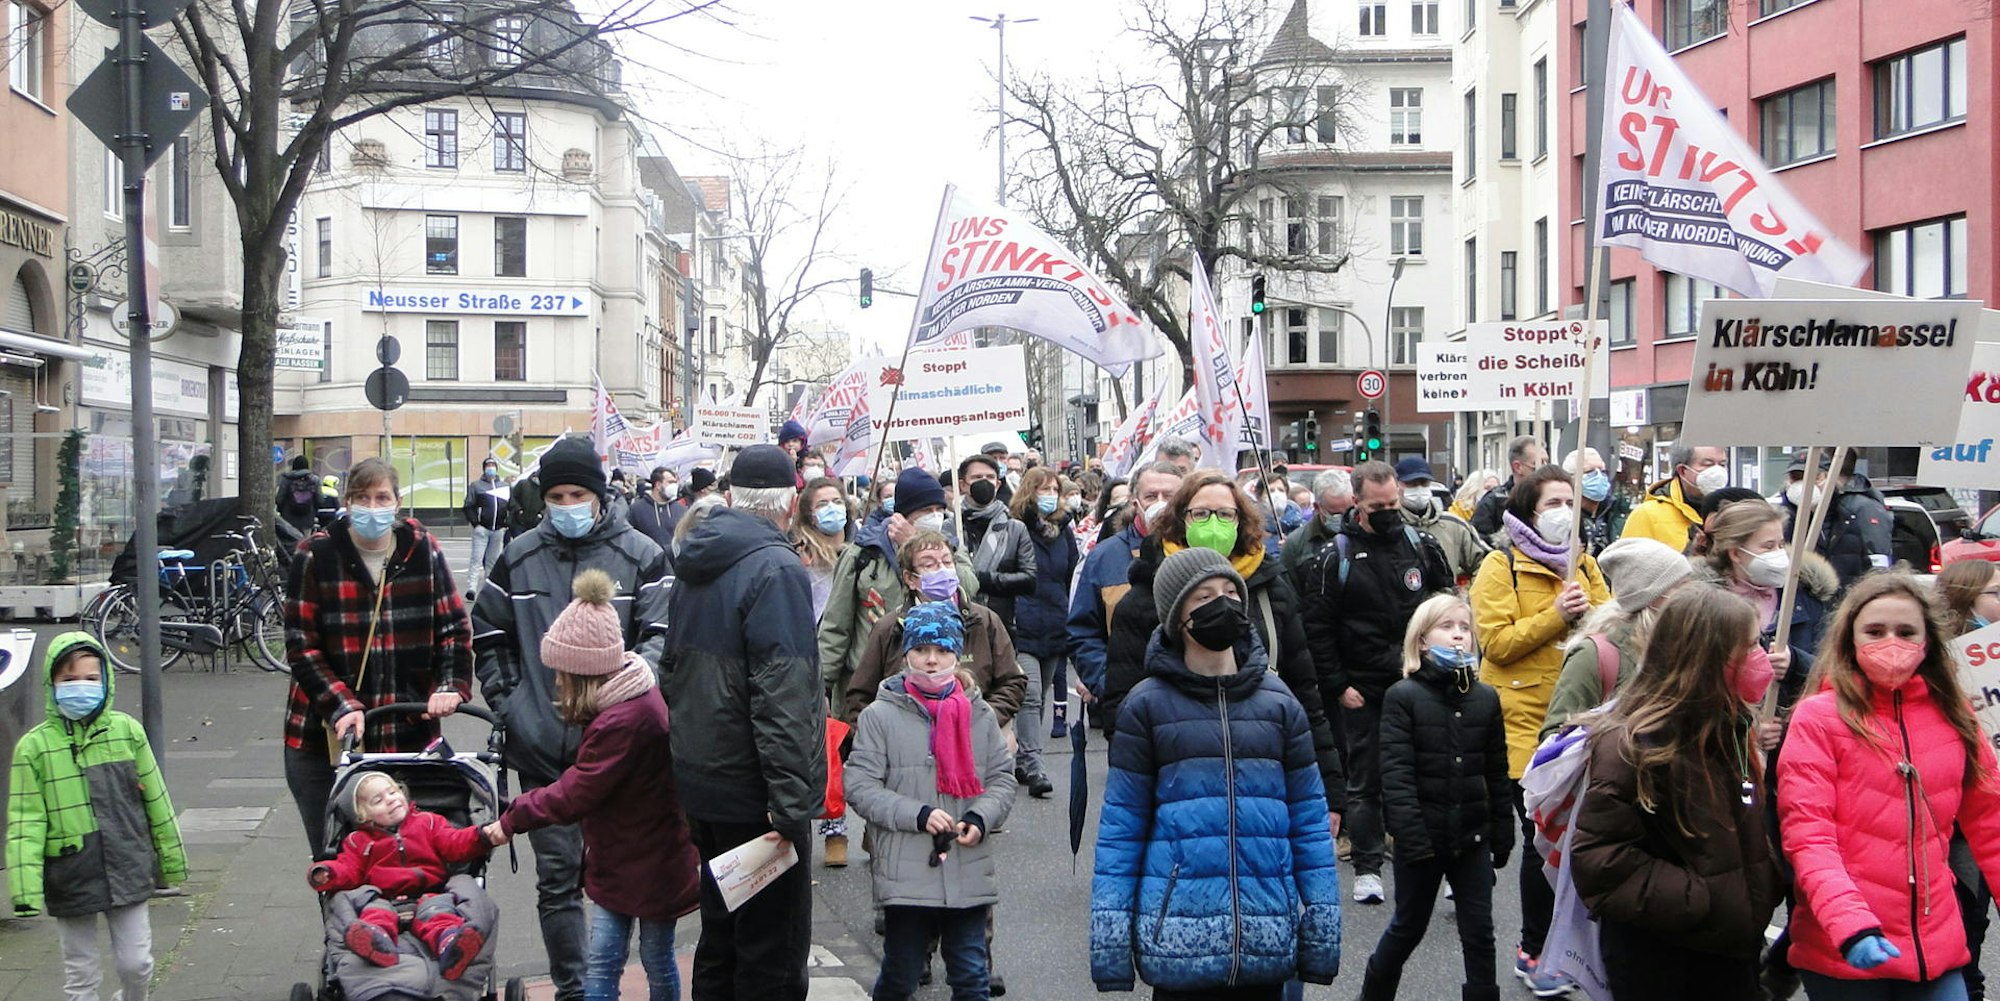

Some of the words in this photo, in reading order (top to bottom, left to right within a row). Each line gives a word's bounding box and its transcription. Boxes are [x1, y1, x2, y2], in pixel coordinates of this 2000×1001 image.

[948, 216, 1008, 245] UNS
[369, 291, 449, 308] Neusser
[458, 293, 522, 310] Straße
[530, 295, 566, 310] 237
[966, 292, 1016, 310] NORDEN
[1504, 327, 1568, 344] Stoppt
[1712, 318, 1957, 348] Klärschlamassel
[923, 360, 967, 373] Stoppt
[1478, 356, 1508, 370] die
[1364, 378, 1380, 391] 30
[1704, 362, 1734, 392] in
[1742, 362, 1819, 391] Köln!
[1423, 389, 1459, 399] keine
[1499, 383, 1516, 397] in
[1524, 382, 1574, 397] Köln!
[702, 420, 754, 429] Klärschlamm
